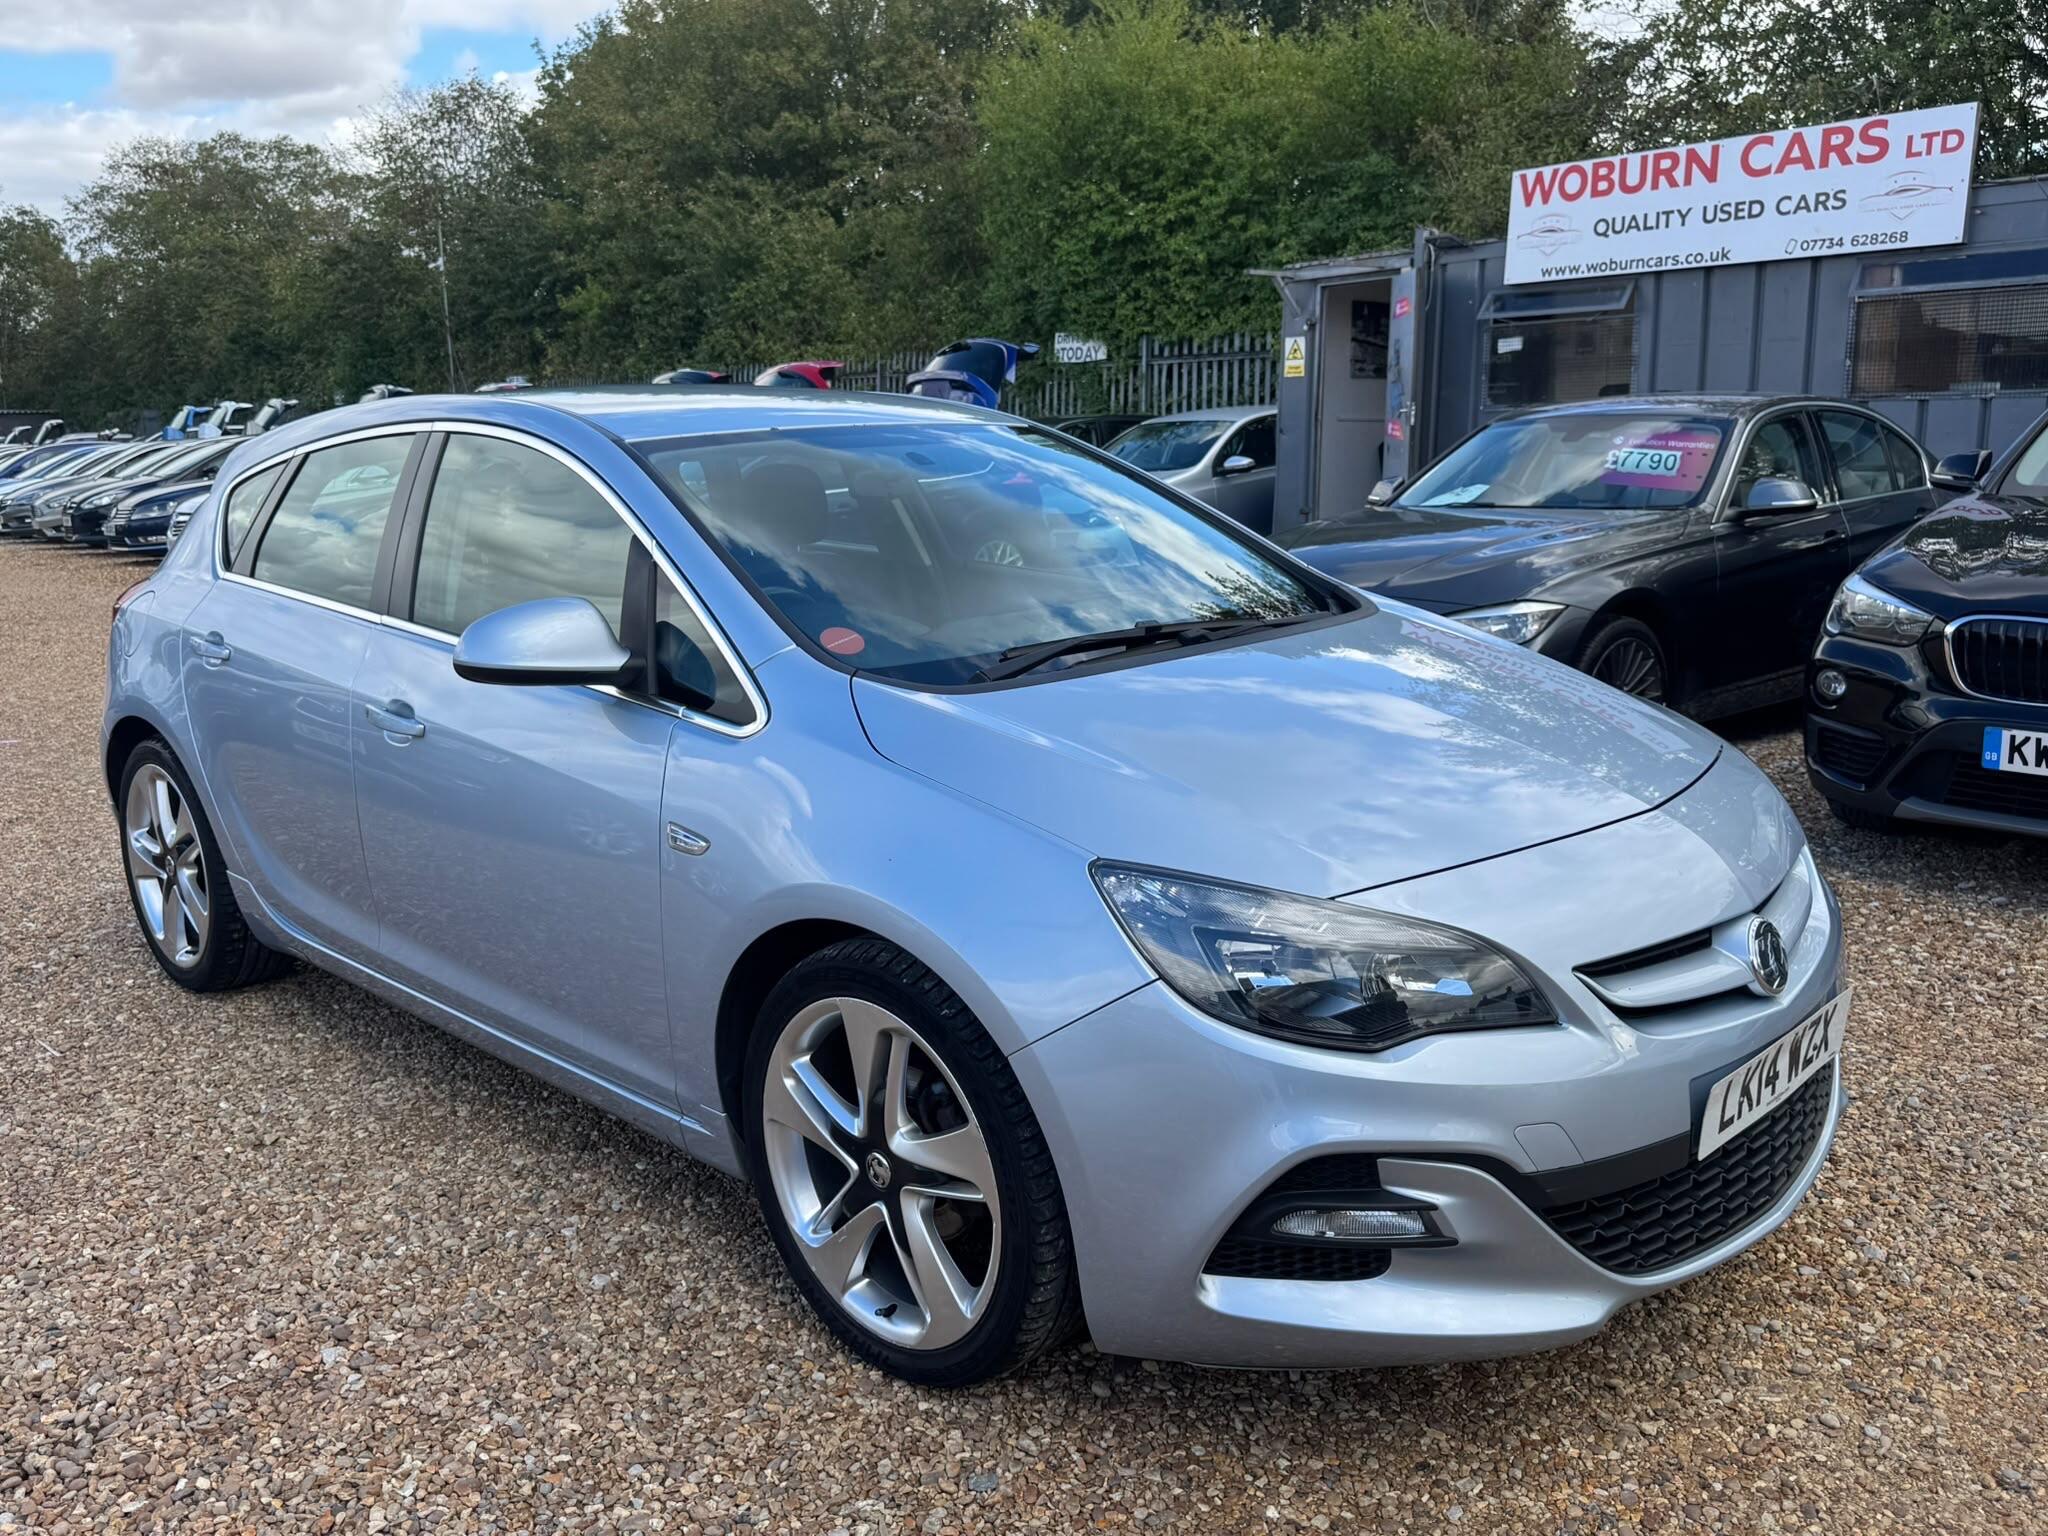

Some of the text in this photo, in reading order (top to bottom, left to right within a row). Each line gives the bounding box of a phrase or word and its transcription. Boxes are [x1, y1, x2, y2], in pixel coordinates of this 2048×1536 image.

[1519, 118, 1965, 208] WOBURN CARS LTD
[1593, 189, 1847, 238] QUALITY USED CARS
[1800, 231, 1908, 252] 07734 628268
[1540, 246, 1731, 278] www.woburncars.co.uk
[1060, 345, 1102, 362] TODAY
[1718, 1003, 1838, 1134] LK14 WZX
